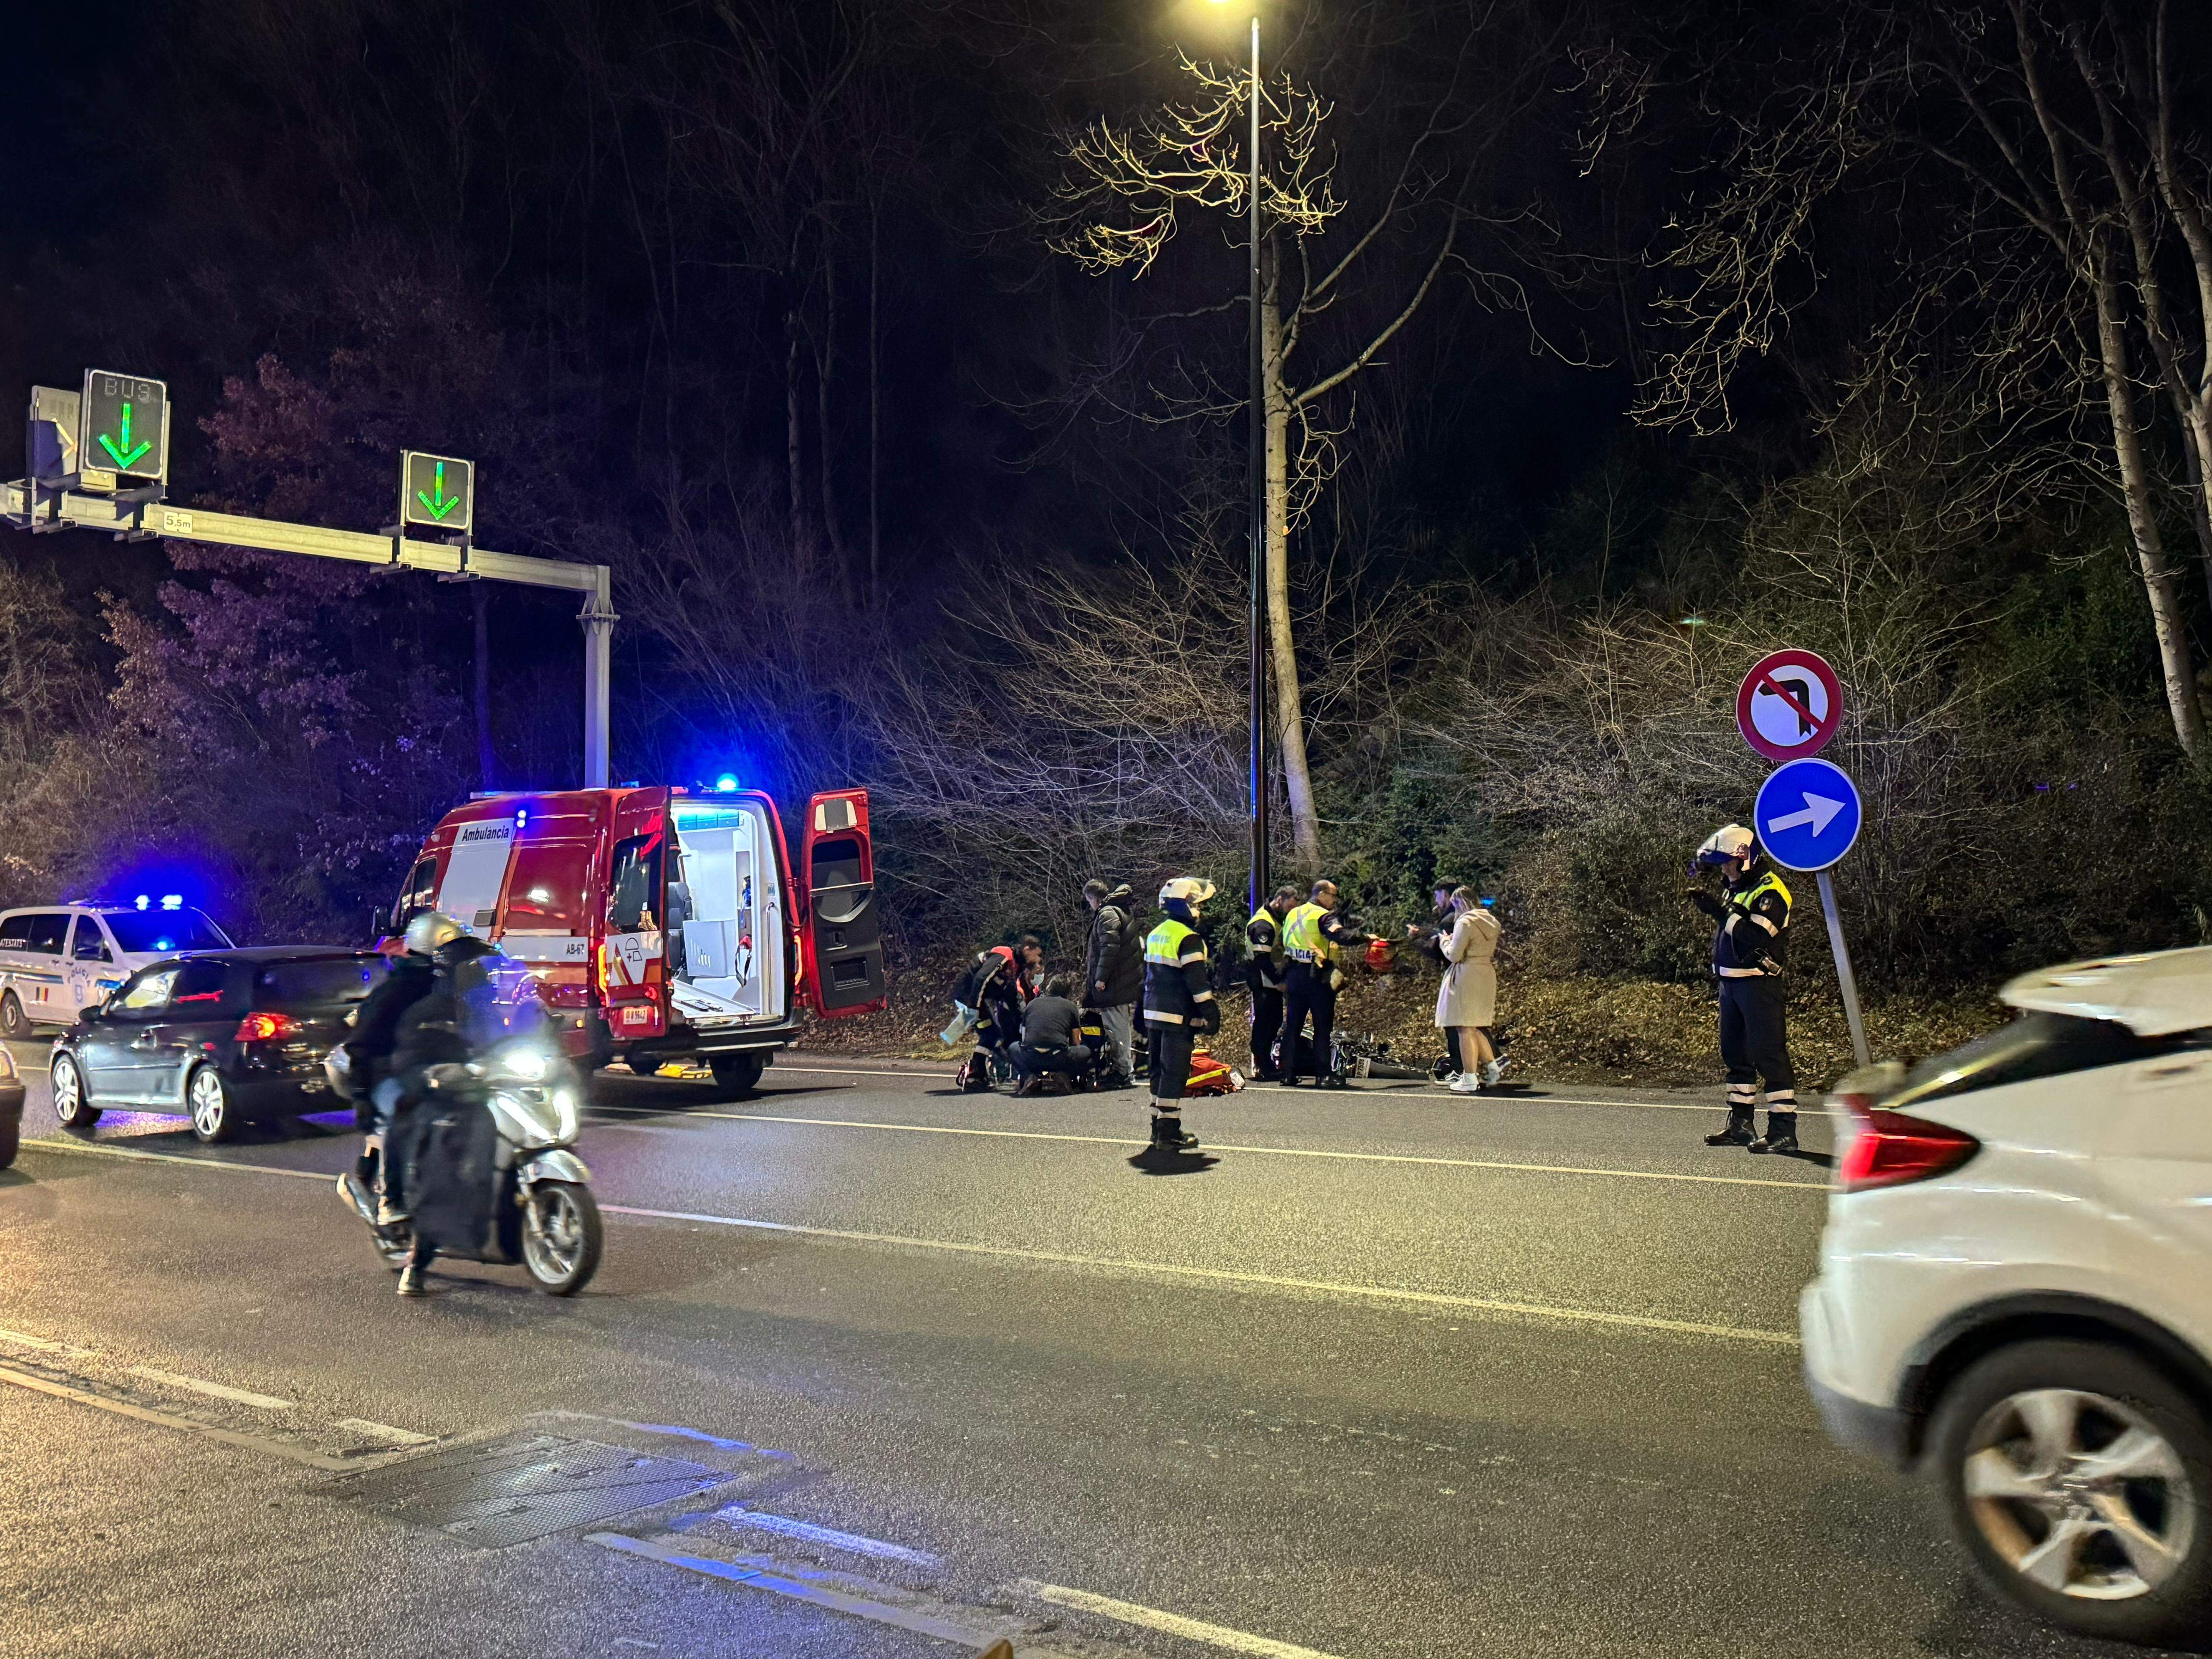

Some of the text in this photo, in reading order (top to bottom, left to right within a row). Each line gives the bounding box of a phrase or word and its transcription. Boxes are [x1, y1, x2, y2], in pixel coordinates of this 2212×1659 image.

[105, 377, 150, 402] BUS
[166, 515, 191, 528] 5,5m
[566, 944, 584, 955] AB-67
